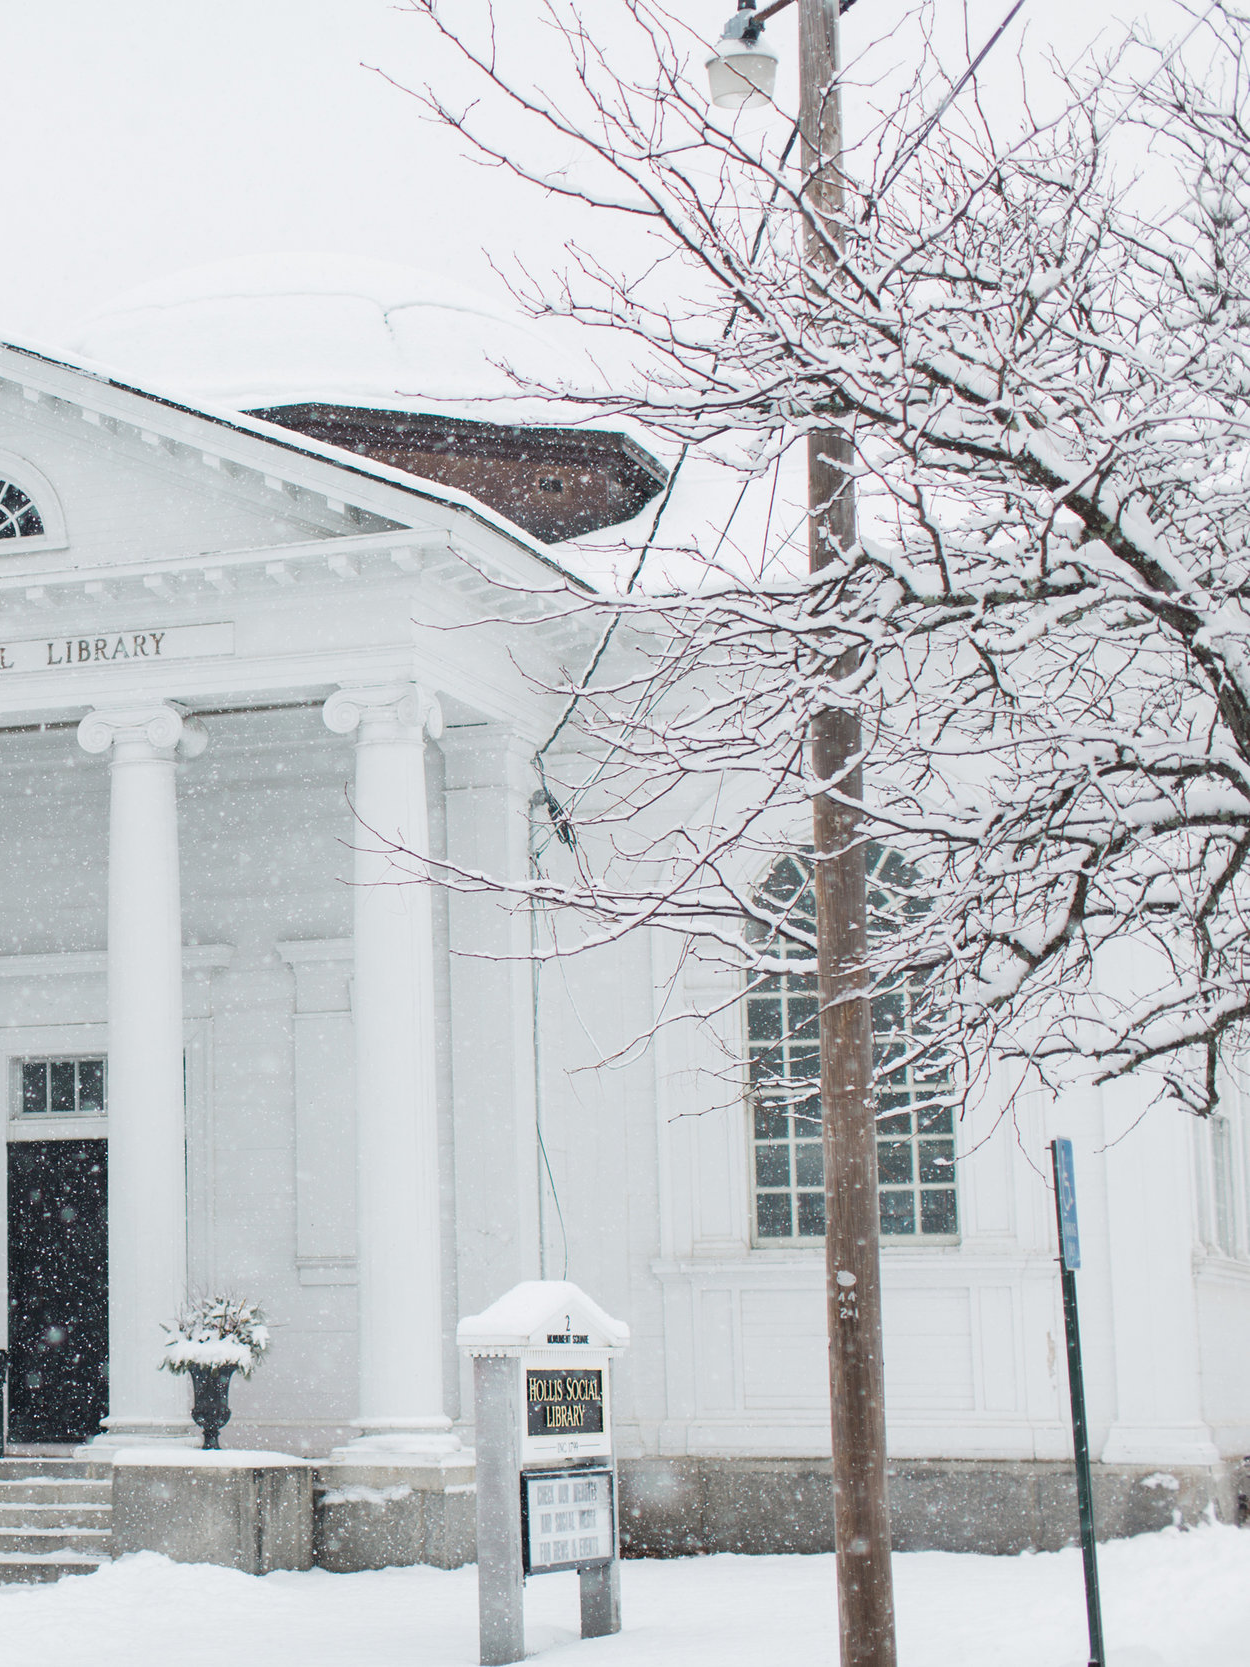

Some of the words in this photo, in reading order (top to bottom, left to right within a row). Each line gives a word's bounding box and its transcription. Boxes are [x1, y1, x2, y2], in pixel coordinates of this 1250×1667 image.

[46, 632, 167, 666] LIBRARY
[565, 1314, 571, 1331] 2
[529, 1378, 563, 1402] HOLLIS
[566, 1377, 600, 1401] SOCIAL
[546, 1404, 585, 1427] LIBRARY
